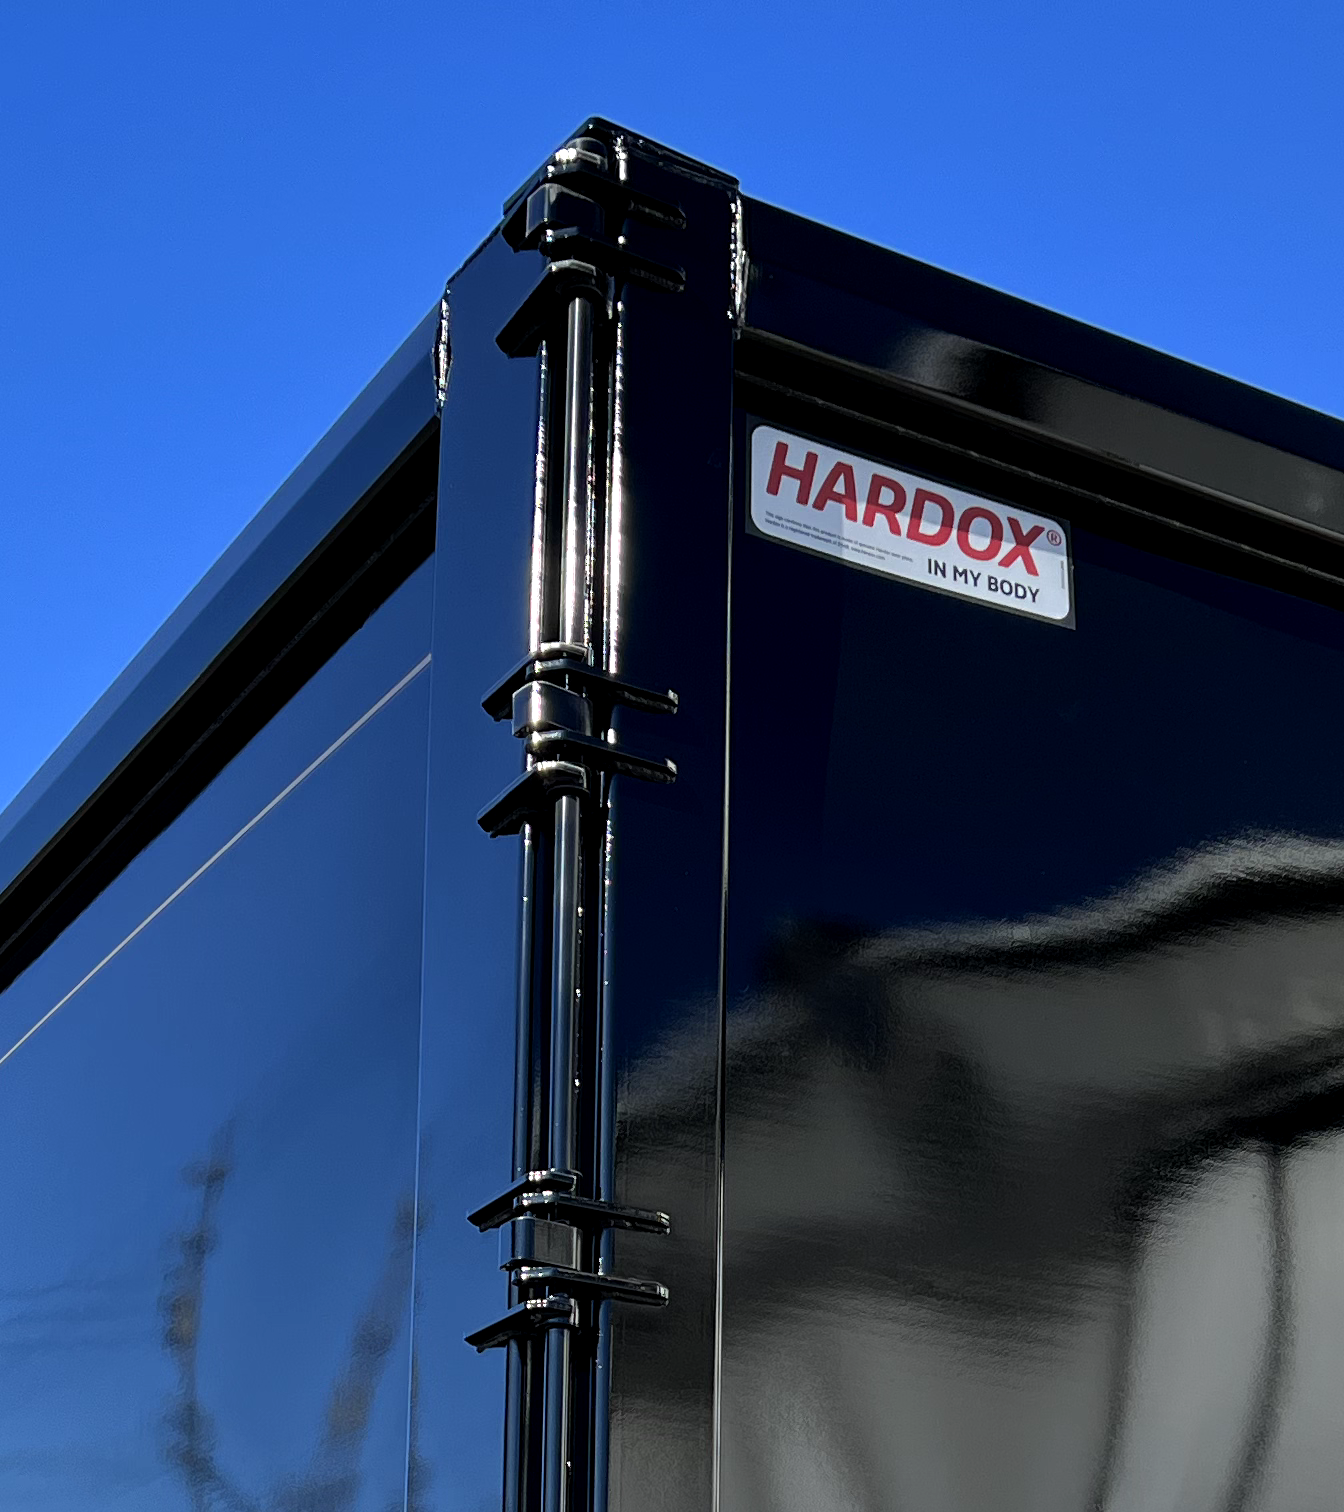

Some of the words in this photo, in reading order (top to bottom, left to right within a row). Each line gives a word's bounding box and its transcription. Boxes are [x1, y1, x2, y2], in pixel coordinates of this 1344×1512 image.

[927, 557, 948, 578] IN
[953, 565, 982, 589] MY
[987, 575, 1040, 603] BODY
